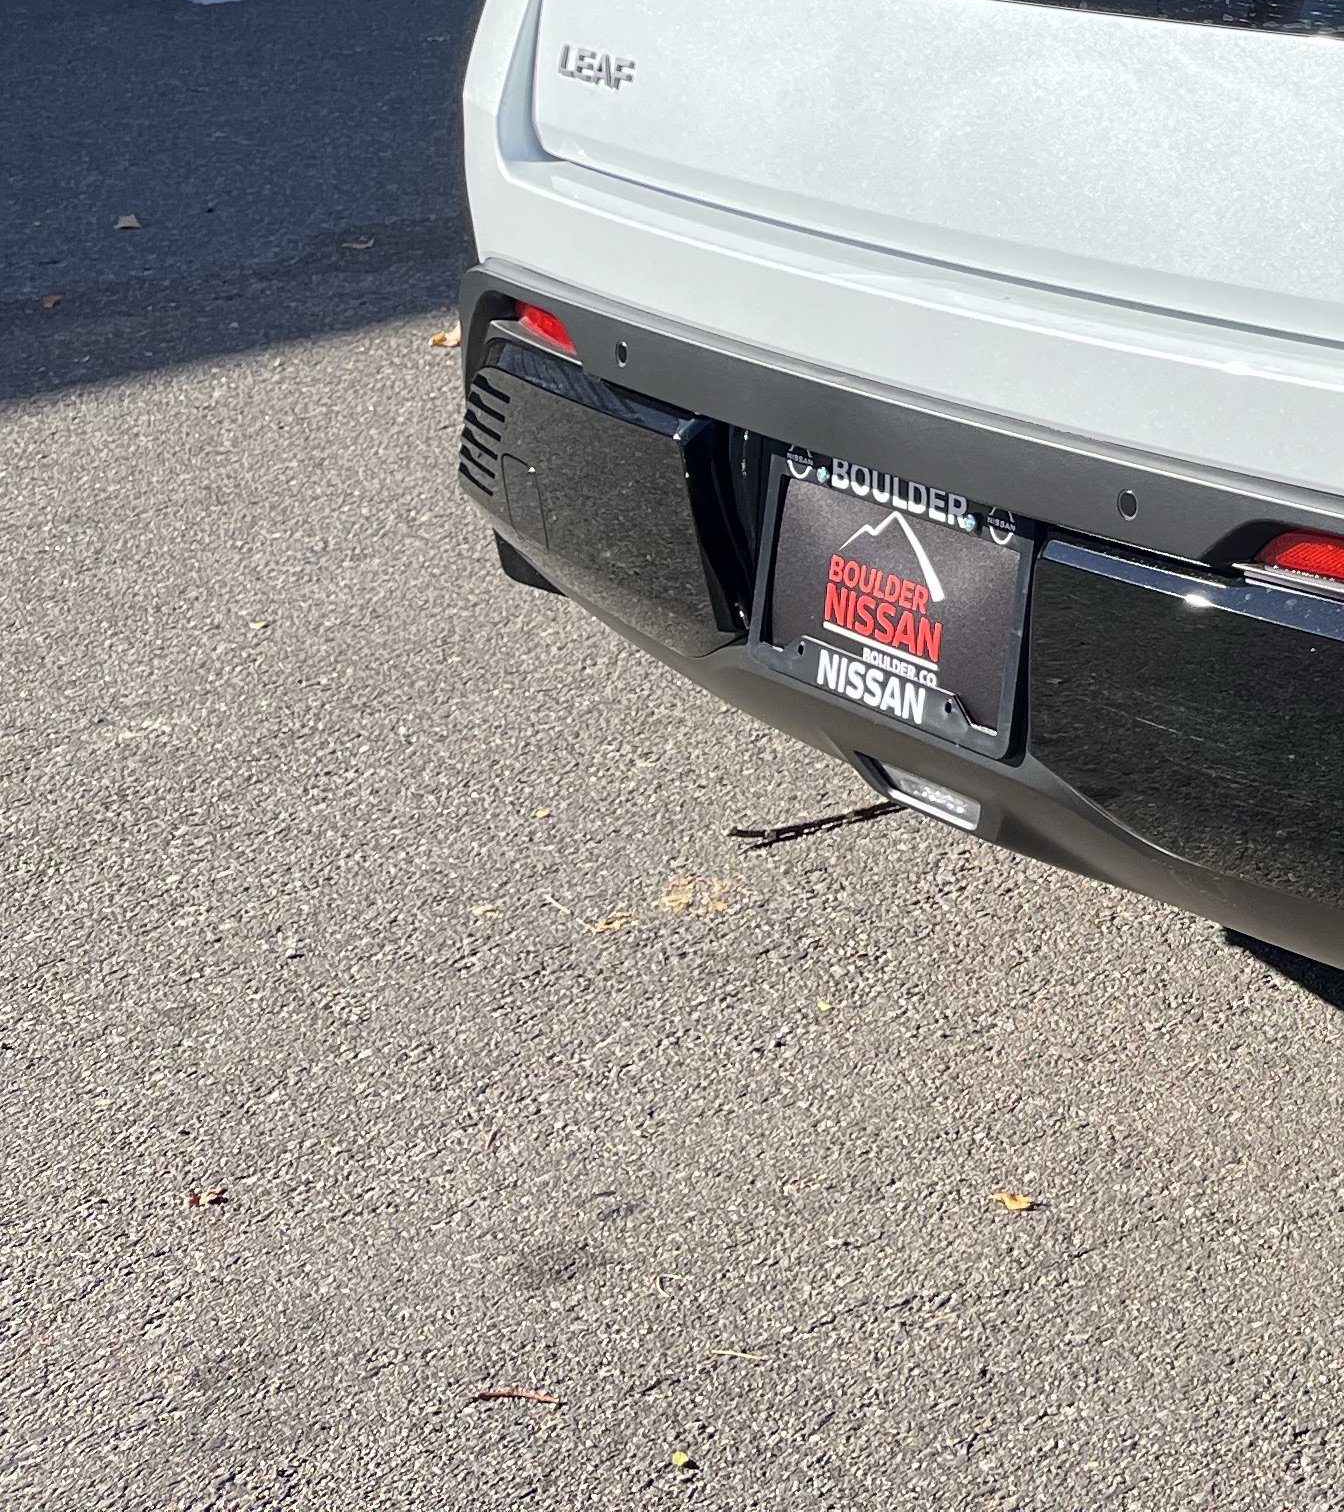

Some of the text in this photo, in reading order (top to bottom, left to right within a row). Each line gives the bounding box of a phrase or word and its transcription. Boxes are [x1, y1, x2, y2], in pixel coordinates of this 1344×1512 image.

[558, 44, 636, 90] LEAF
[787, 452, 814, 467] NISSAN
[831, 457, 968, 526] BOULDER
[986, 516, 1016, 532] NISSAN
[829, 554, 929, 615] BOULDER
[824, 583, 943, 663] NISSAN
[816, 649, 926, 725] NISSAN
